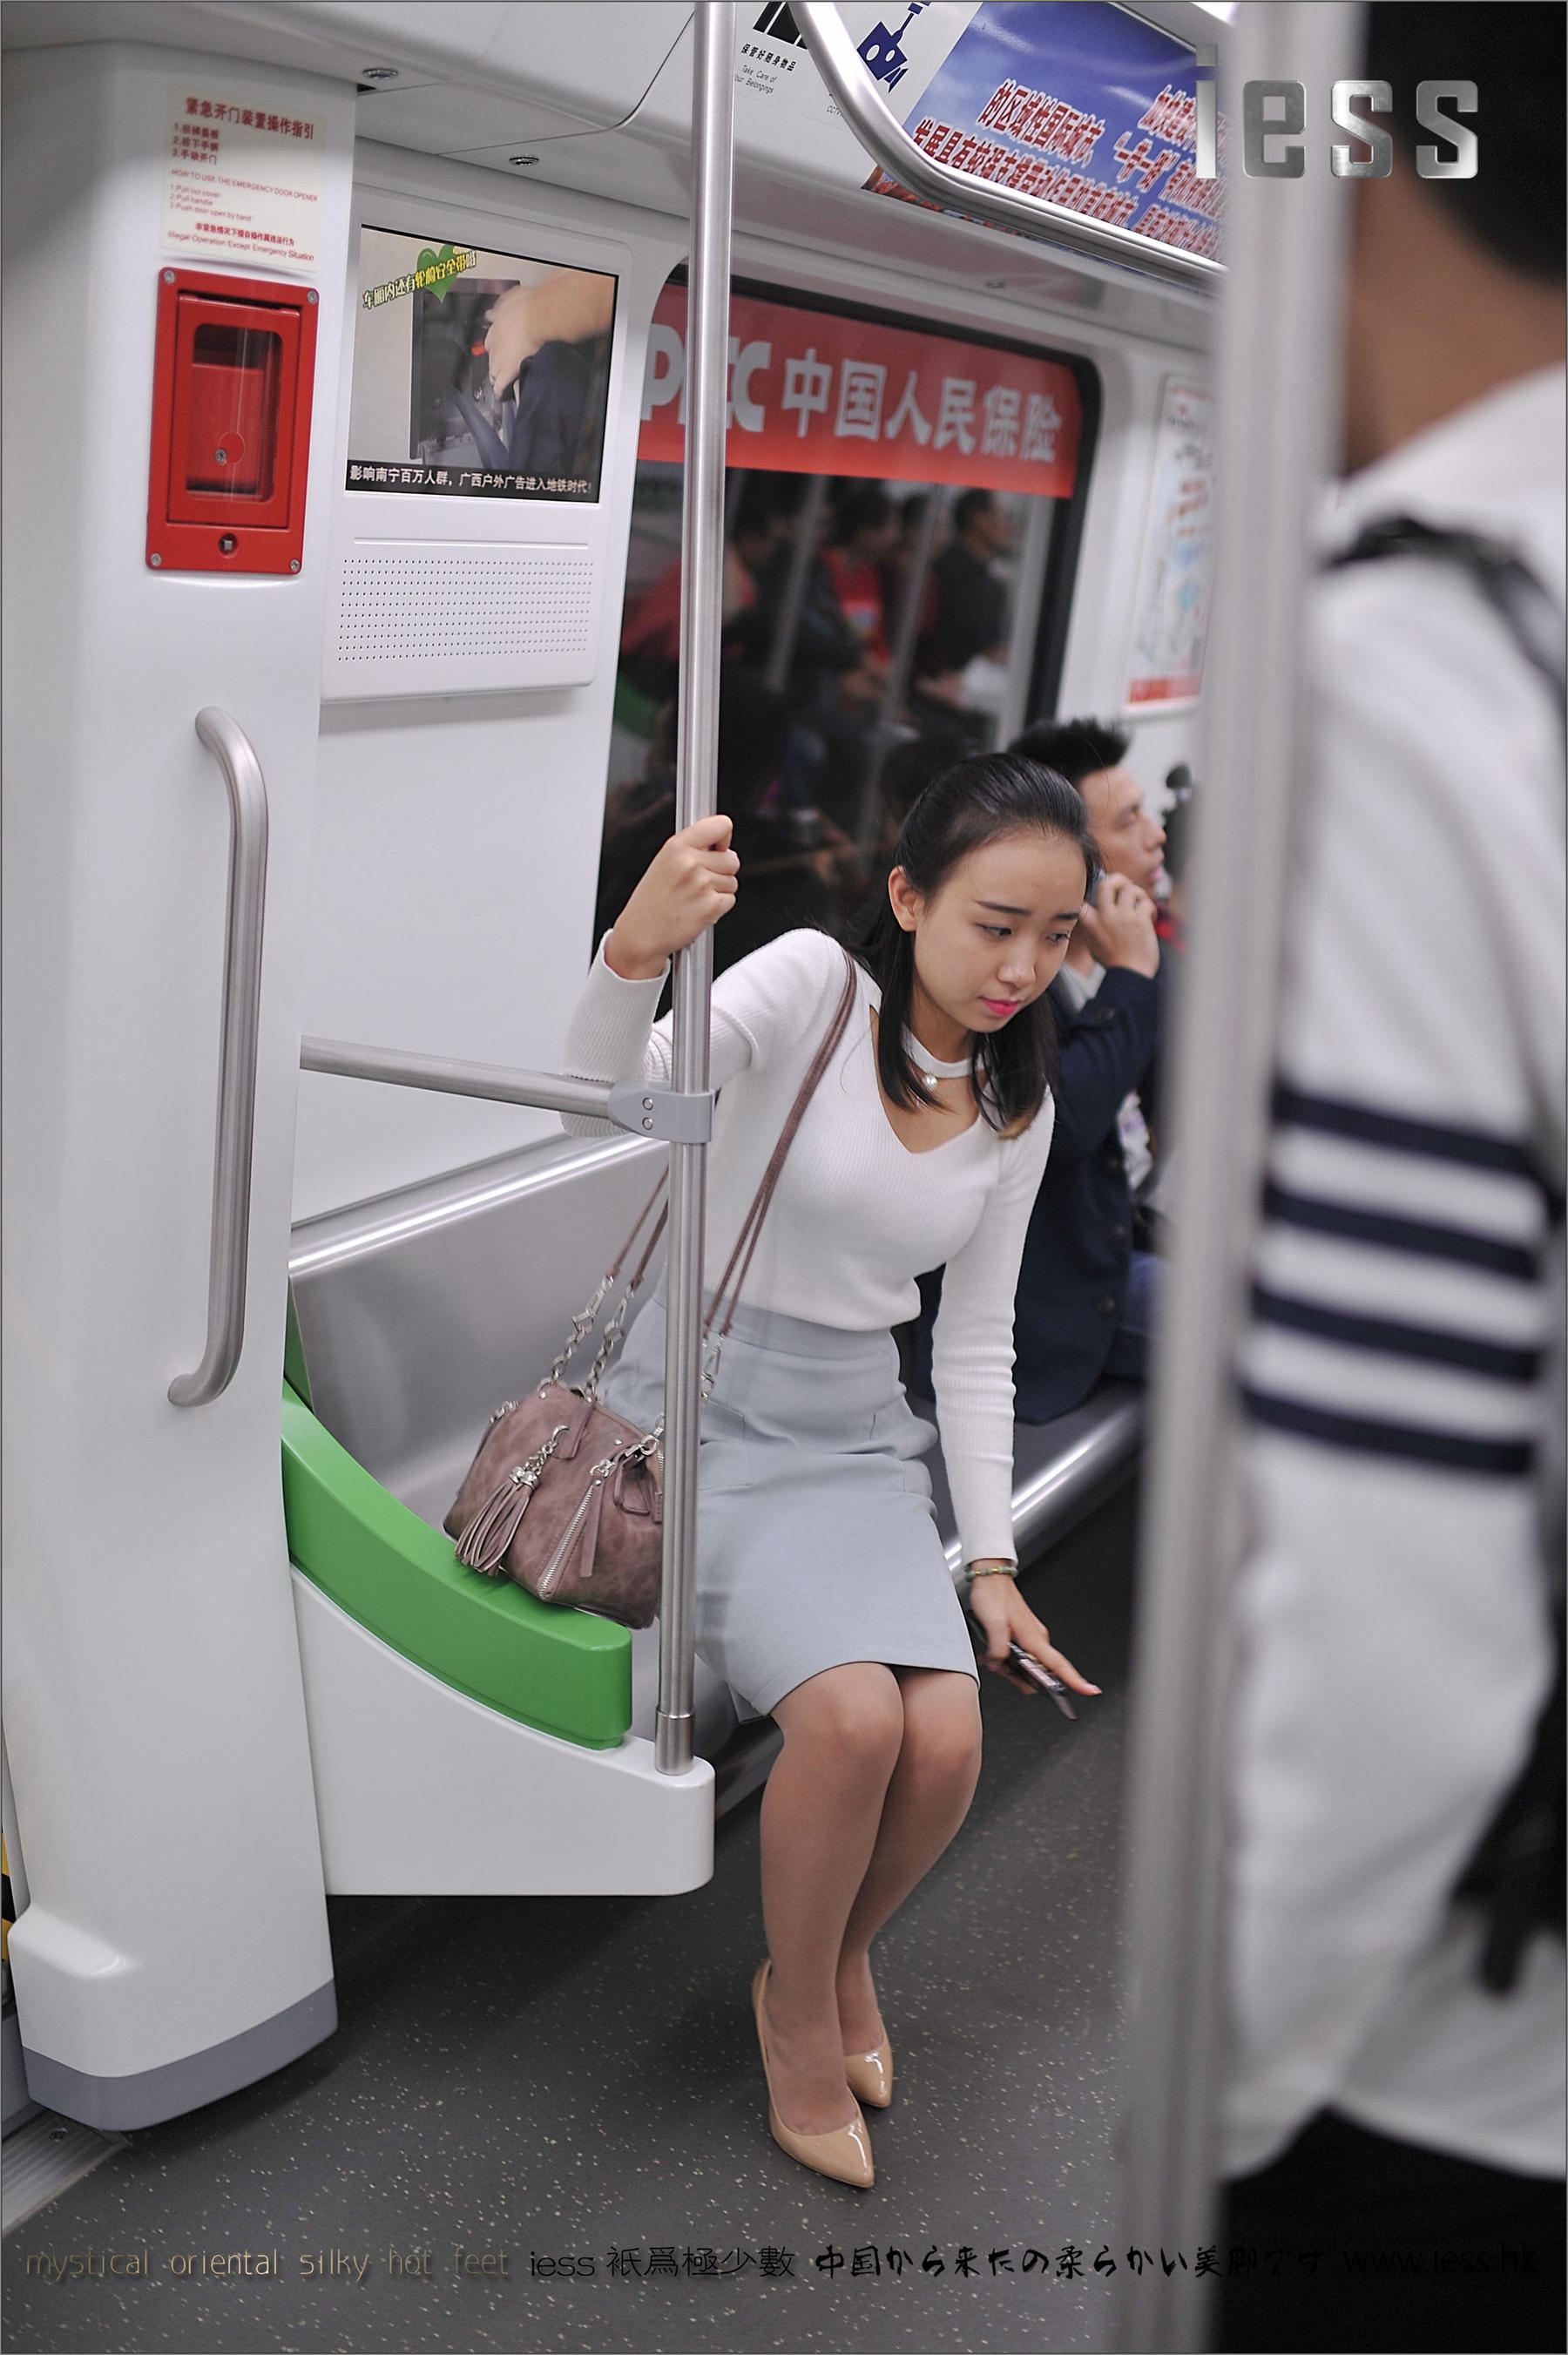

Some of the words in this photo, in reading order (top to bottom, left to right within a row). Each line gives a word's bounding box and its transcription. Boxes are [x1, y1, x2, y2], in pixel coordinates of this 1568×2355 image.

[741, 44, 796, 71] 保管好随身物品
[742, 65, 754, 76] Take
[756, 71, 769, 81] Care
[746, 78, 774, 95] Belongings
[186, 97, 314, 140] 紧急开门装置操作指引
[191, 172, 200, 180] TO
[217, 177, 230, 186] THE
[232, 179, 274, 193] EMERGENCY
[274, 187, 292, 197] DOOR
[294, 192, 318, 202] OPENER
[191, 197, 213, 206] handle
[210, 210, 226, 219] open
[169, 230, 191, 241] Illegal
[193, 234, 226, 247] Operation
[227, 240, 251, 251] Except
[253, 244, 287, 257] Emergency
[288, 250, 314, 261] Situation
[782, 349, 1063, 462] 中国人民保险
